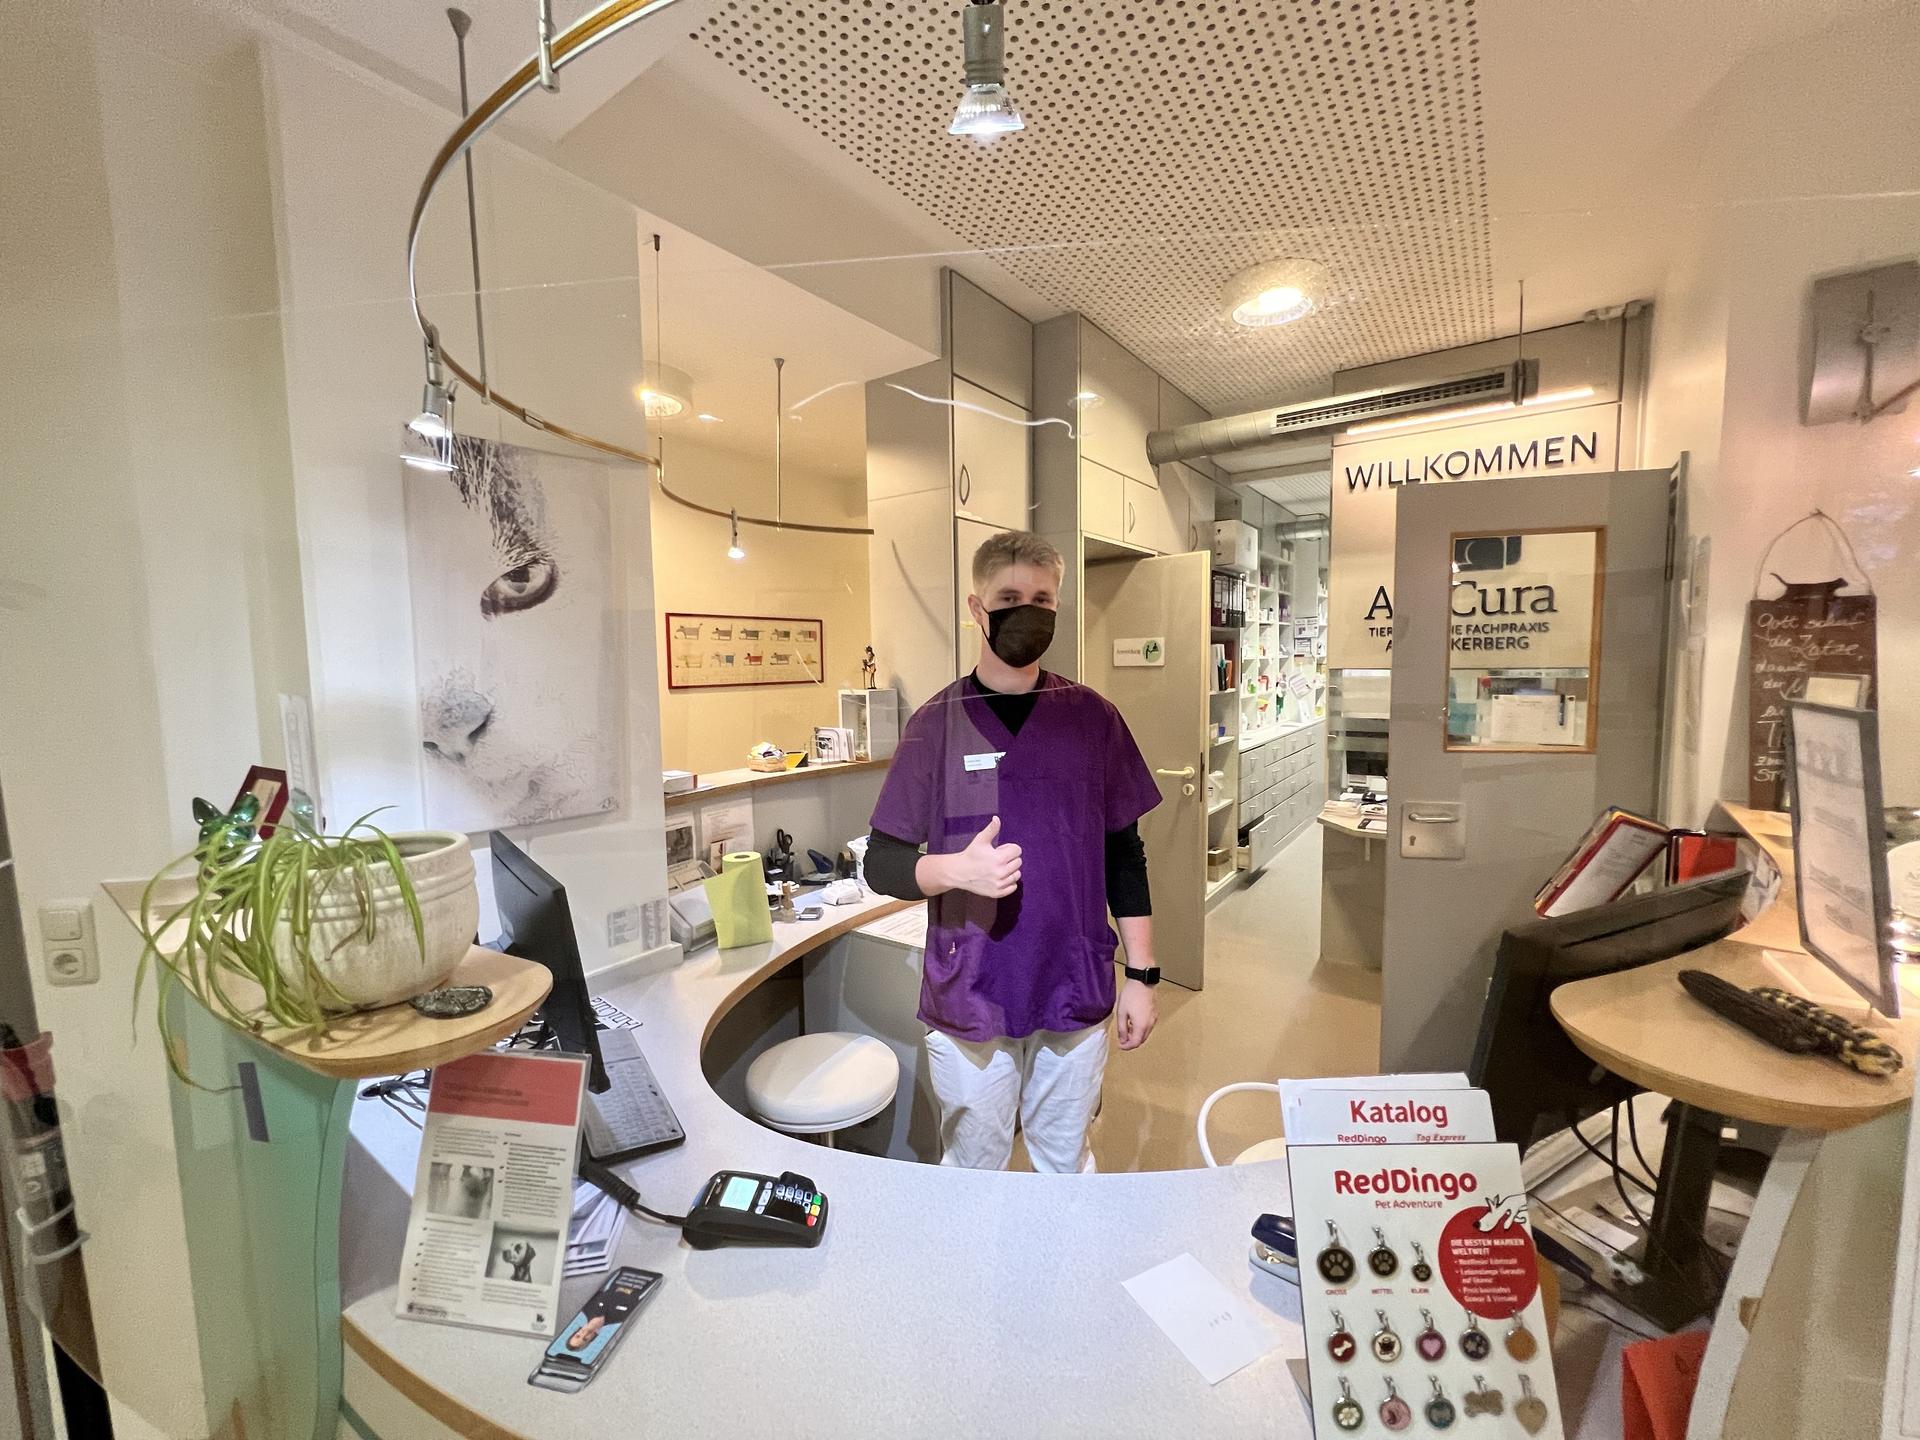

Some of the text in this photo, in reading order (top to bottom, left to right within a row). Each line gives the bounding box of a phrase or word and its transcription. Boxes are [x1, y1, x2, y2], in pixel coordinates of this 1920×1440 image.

[1345, 432, 1597, 490] WILLKOMMEN
[1364, 580, 1558, 620] ACura
[1466, 622, 1550, 636] FACHPRAXIS
[1350, 1100, 1448, 1128] Katalog
[1337, 1133, 1466, 1144] RedDingo Tag Express
[1334, 1167, 1477, 1200] RedDingo
[1375, 1200, 1443, 1209] Pet Adventure
